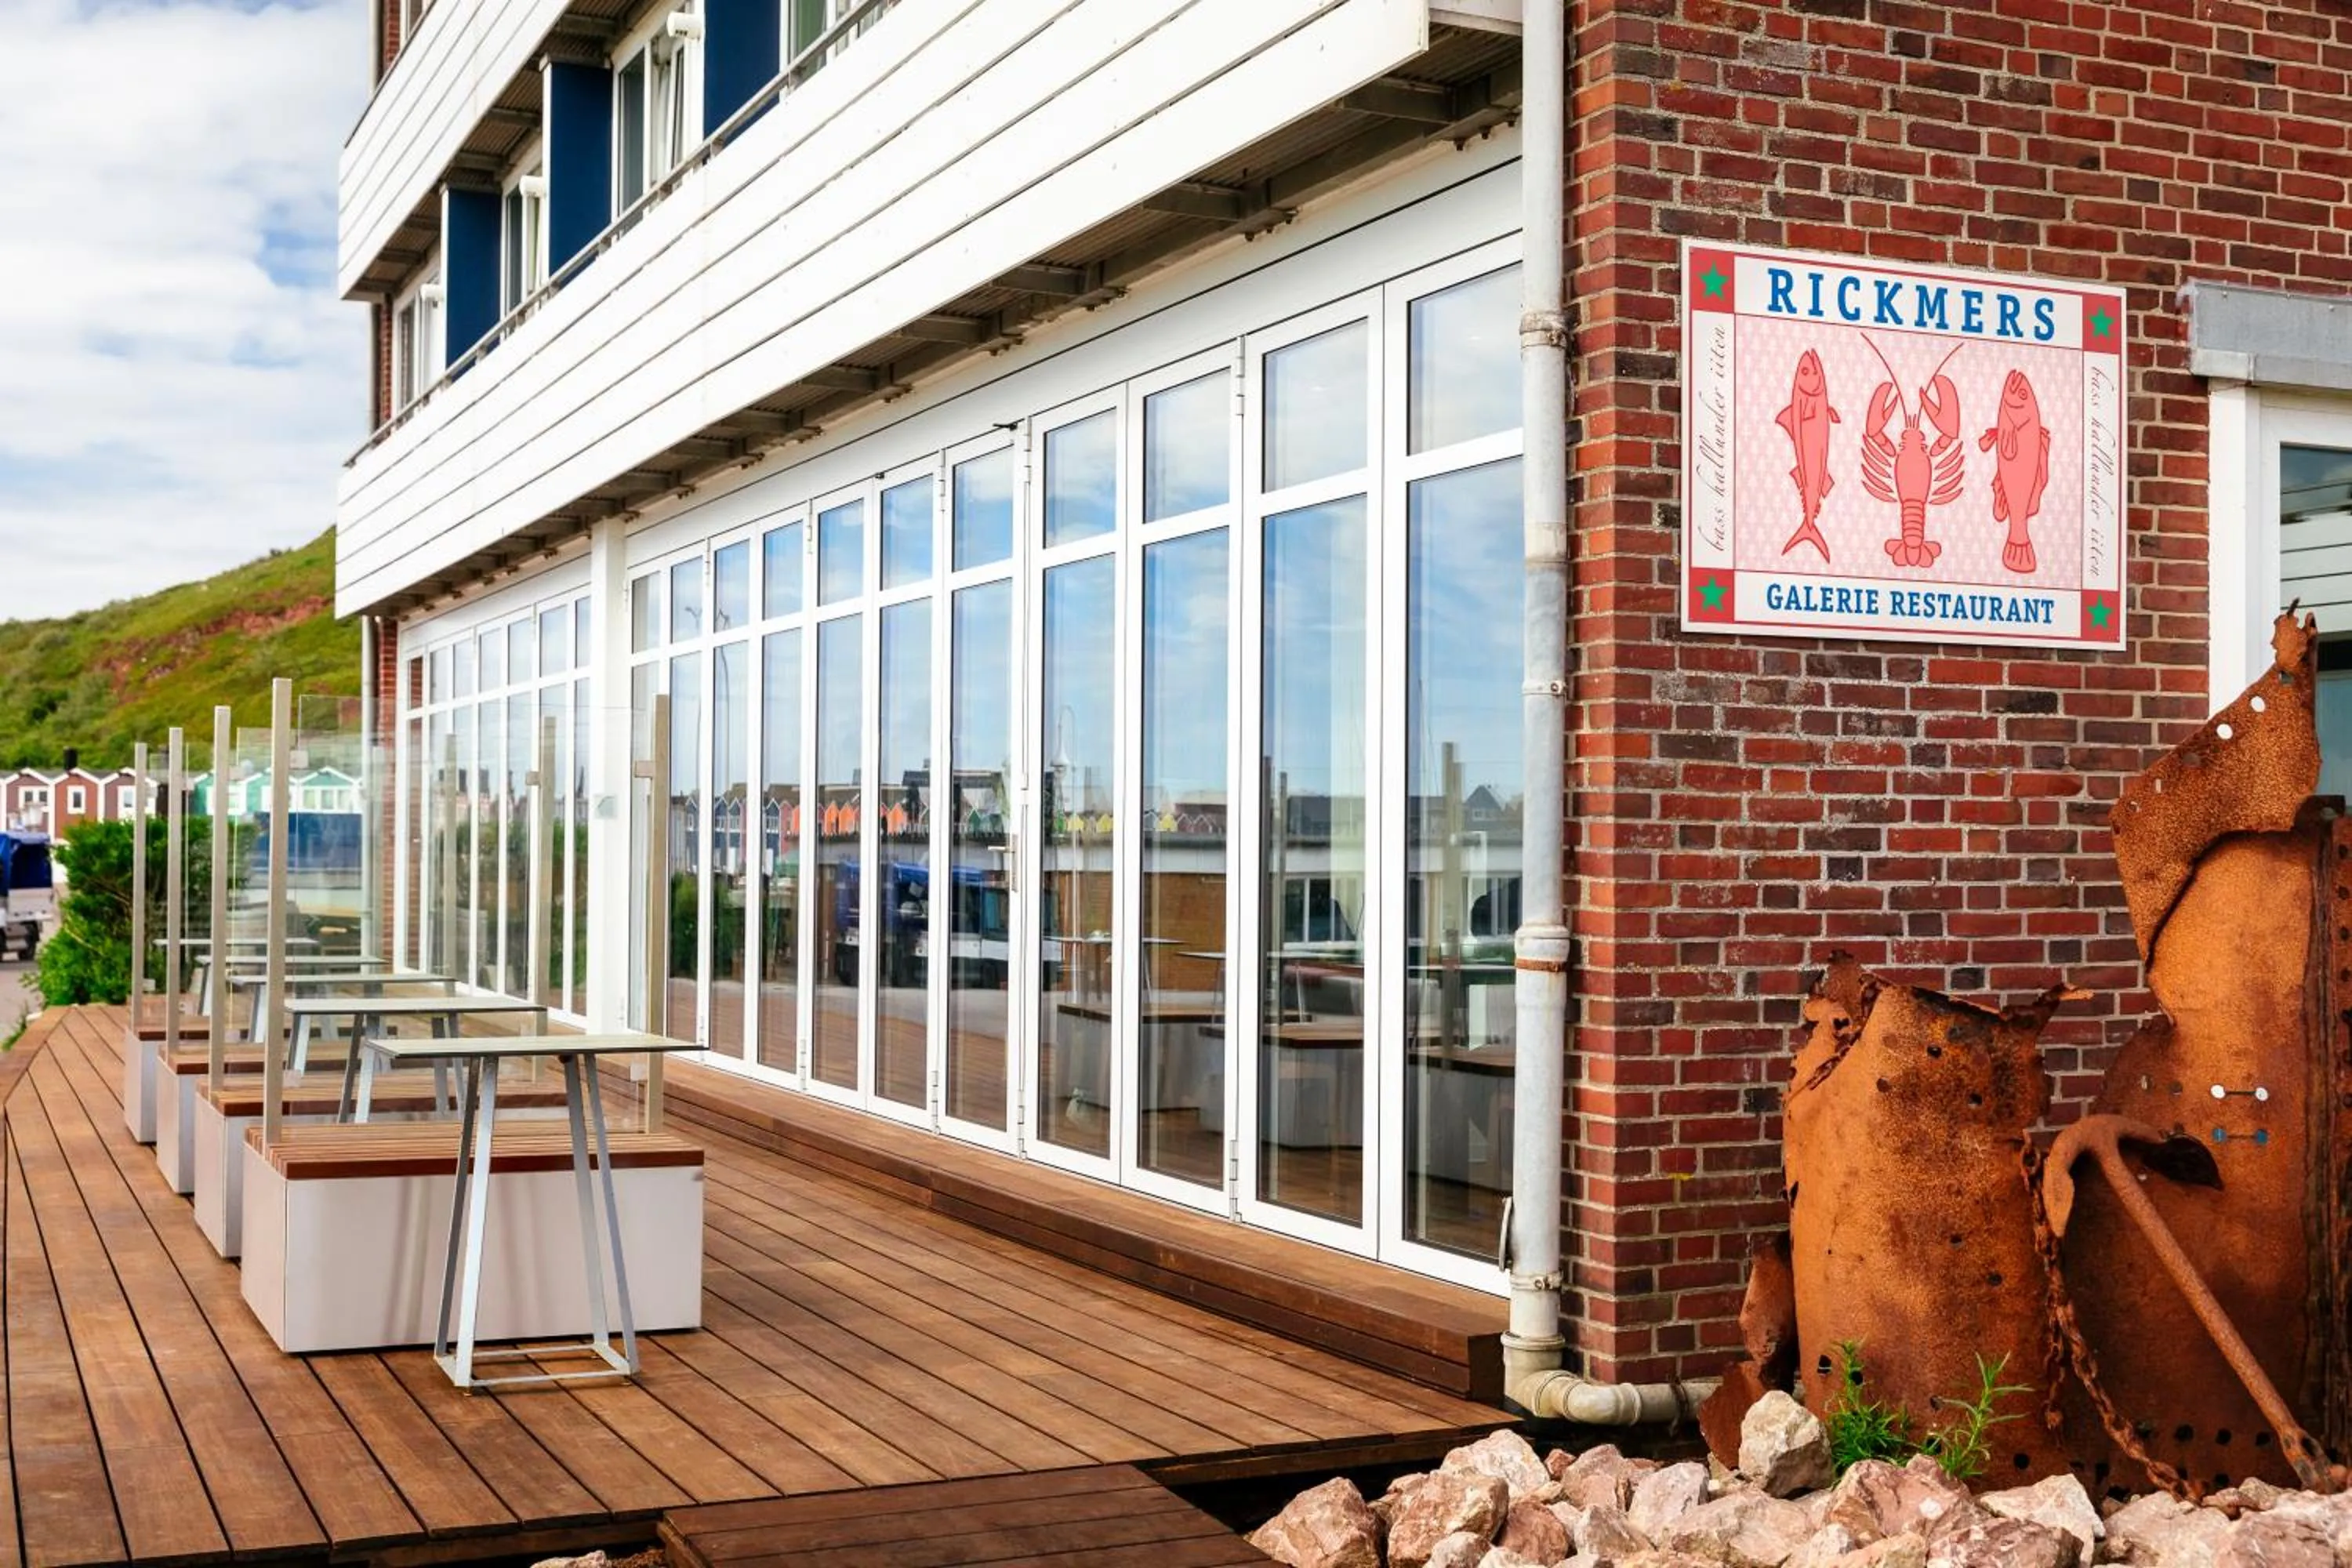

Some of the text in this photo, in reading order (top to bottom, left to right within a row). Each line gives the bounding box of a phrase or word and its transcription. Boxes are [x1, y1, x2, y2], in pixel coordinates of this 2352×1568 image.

[1768, 268, 2055, 341] RICKMERS
[1709, 326, 1725, 378] iiten
[1696, 387, 1726, 497] hallunder
[2089, 416, 2116, 520] hallunder
[1766, 583, 2054, 623] GALERIE RESTAURANT
